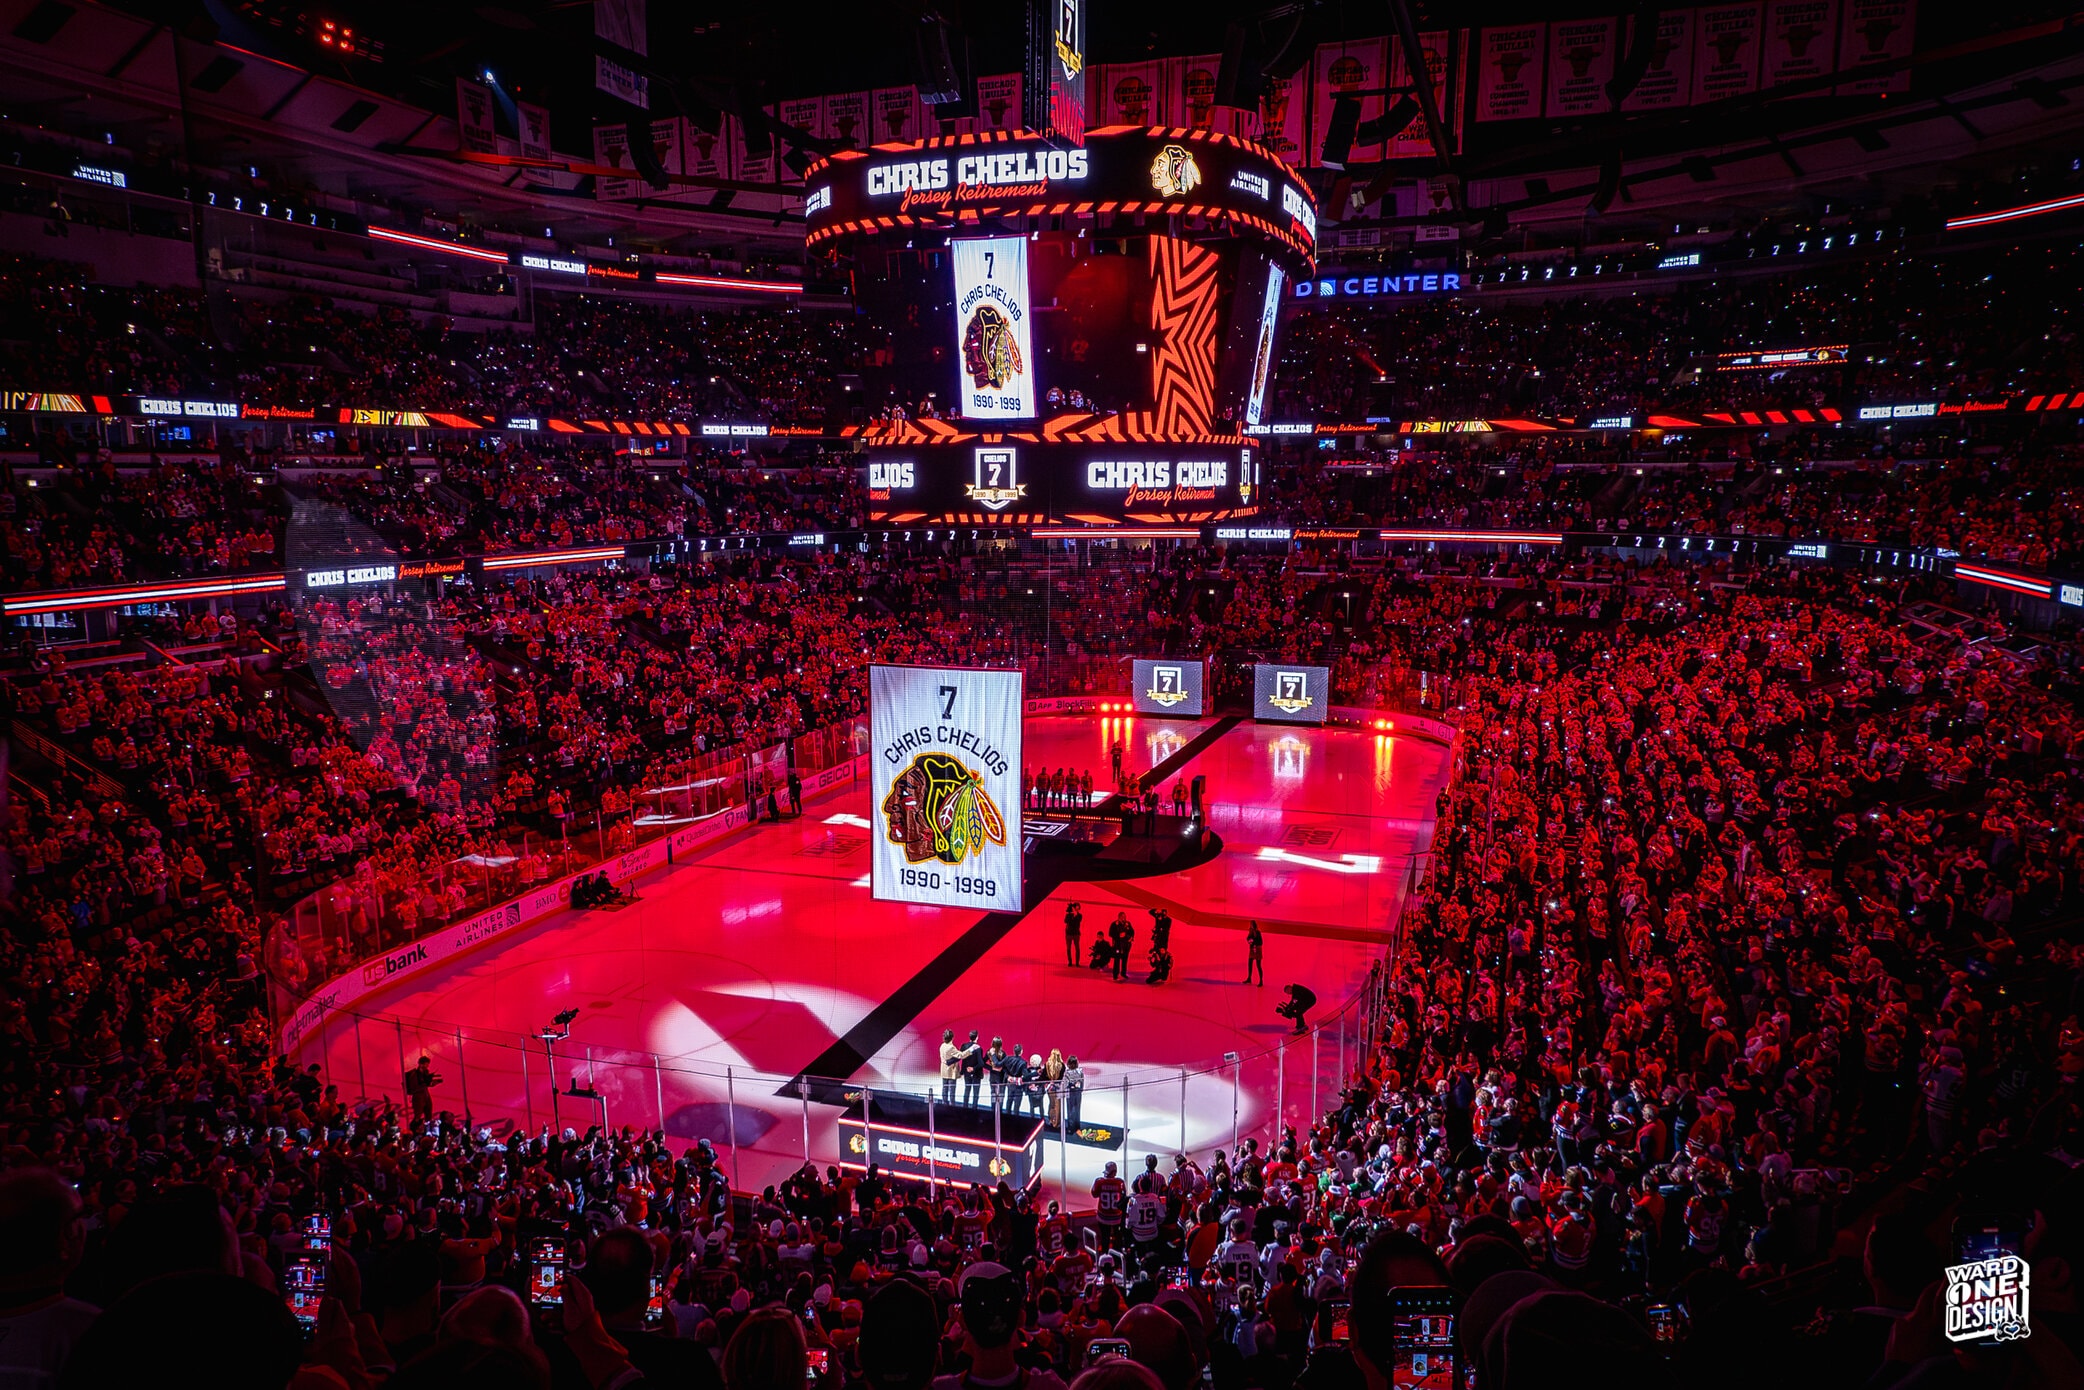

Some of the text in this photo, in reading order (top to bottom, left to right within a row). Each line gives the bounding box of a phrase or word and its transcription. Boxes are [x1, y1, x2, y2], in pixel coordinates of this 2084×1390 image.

[72, 169, 113, 184] AIRLINES
[79, 165, 112, 179] UNITED
[867, 149, 1089, 196] CHRIS CHELIOS
[1238, 170, 1262, 186] UNITED
[901, 175, 1048, 210] Jersey Retirement
[1230, 178, 1262, 195] AIRLINES
[522, 255, 549, 270] CHRIS
[550, 258, 586, 274] CHELIOS
[984, 252, 994, 279] 7
[1344, 273, 1460, 295] CENTER
[960, 283, 1022, 322] CHRIS CHELIOS
[140, 399, 181, 415] CHRIS
[184, 401, 238, 418] CHELIOS
[1860, 406, 1892, 419] CHRIS
[1893, 403, 1936, 417] CHELIOS
[702, 424, 729, 435] CHRIS
[731, 425, 767, 436] CHELIOS
[1272, 423, 1313, 434] CHELIOS
[989, 463, 1002, 486] 7
[1087, 461, 1170, 488] CHRIS
[1176, 461, 1227, 488] CHELIOS
[1124, 481, 1216, 507] Jersey Retirement
[1217, 528, 1246, 538] CHRIS
[1248, 528, 1291, 539] CHELIOS
[307, 569, 345, 587] CHRIS
[347, 565, 396, 583] CHELIOS
[1162, 677, 1173, 691] 7
[1286, 682, 1296, 697] 7
[939, 685, 958, 719] 7
[884, 725, 1009, 777] CHRIS CHELIOS
[819, 764, 850, 788] GEICO
[535, 892, 556, 910] BMO
[464, 911, 503, 934] UNITED
[454, 921, 504, 949] AIRLINES
[878, 1138, 981, 1168] CHRIS CHELIOS
[1138, 1208, 1156, 1225] 19
